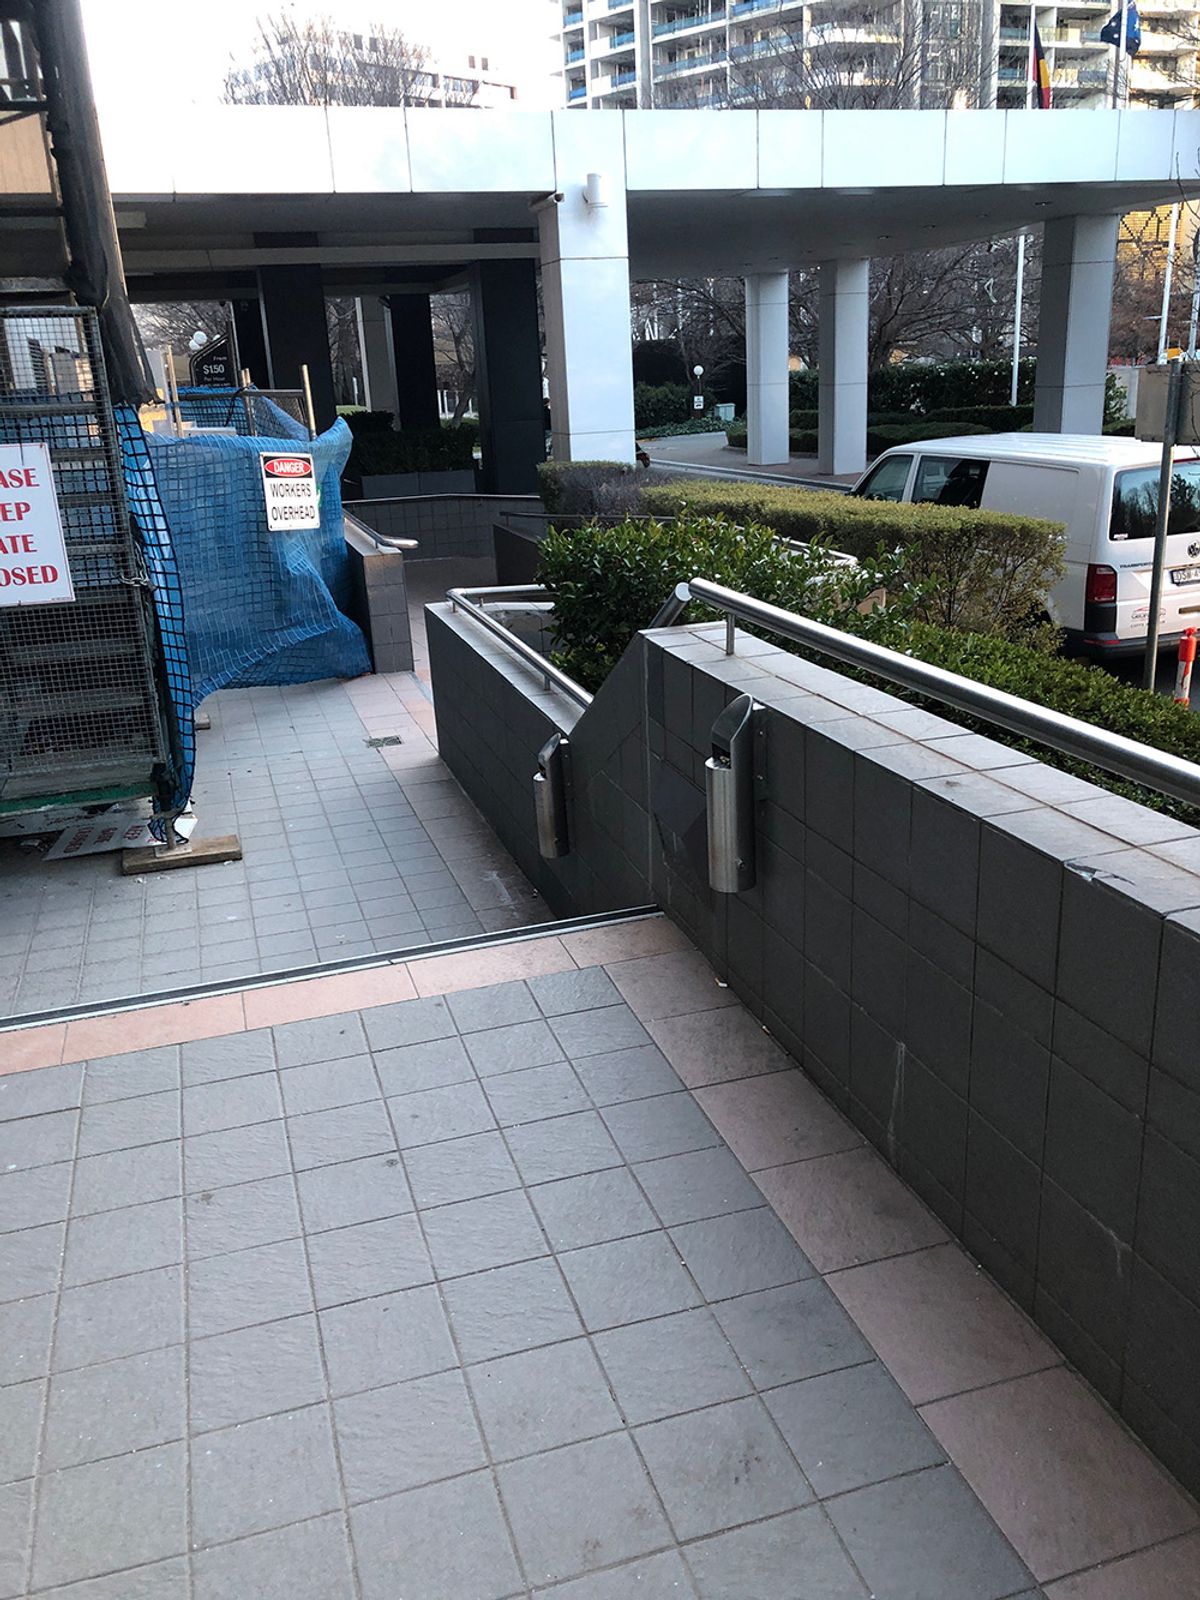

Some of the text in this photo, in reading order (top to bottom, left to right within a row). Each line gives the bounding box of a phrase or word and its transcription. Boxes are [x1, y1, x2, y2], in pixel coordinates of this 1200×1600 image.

[202, 363, 225, 375] $150
[273, 462, 305, 473] DANGER
[270, 483, 312, 498] WORKERS
[271, 505, 316, 521] OVERHEAD
